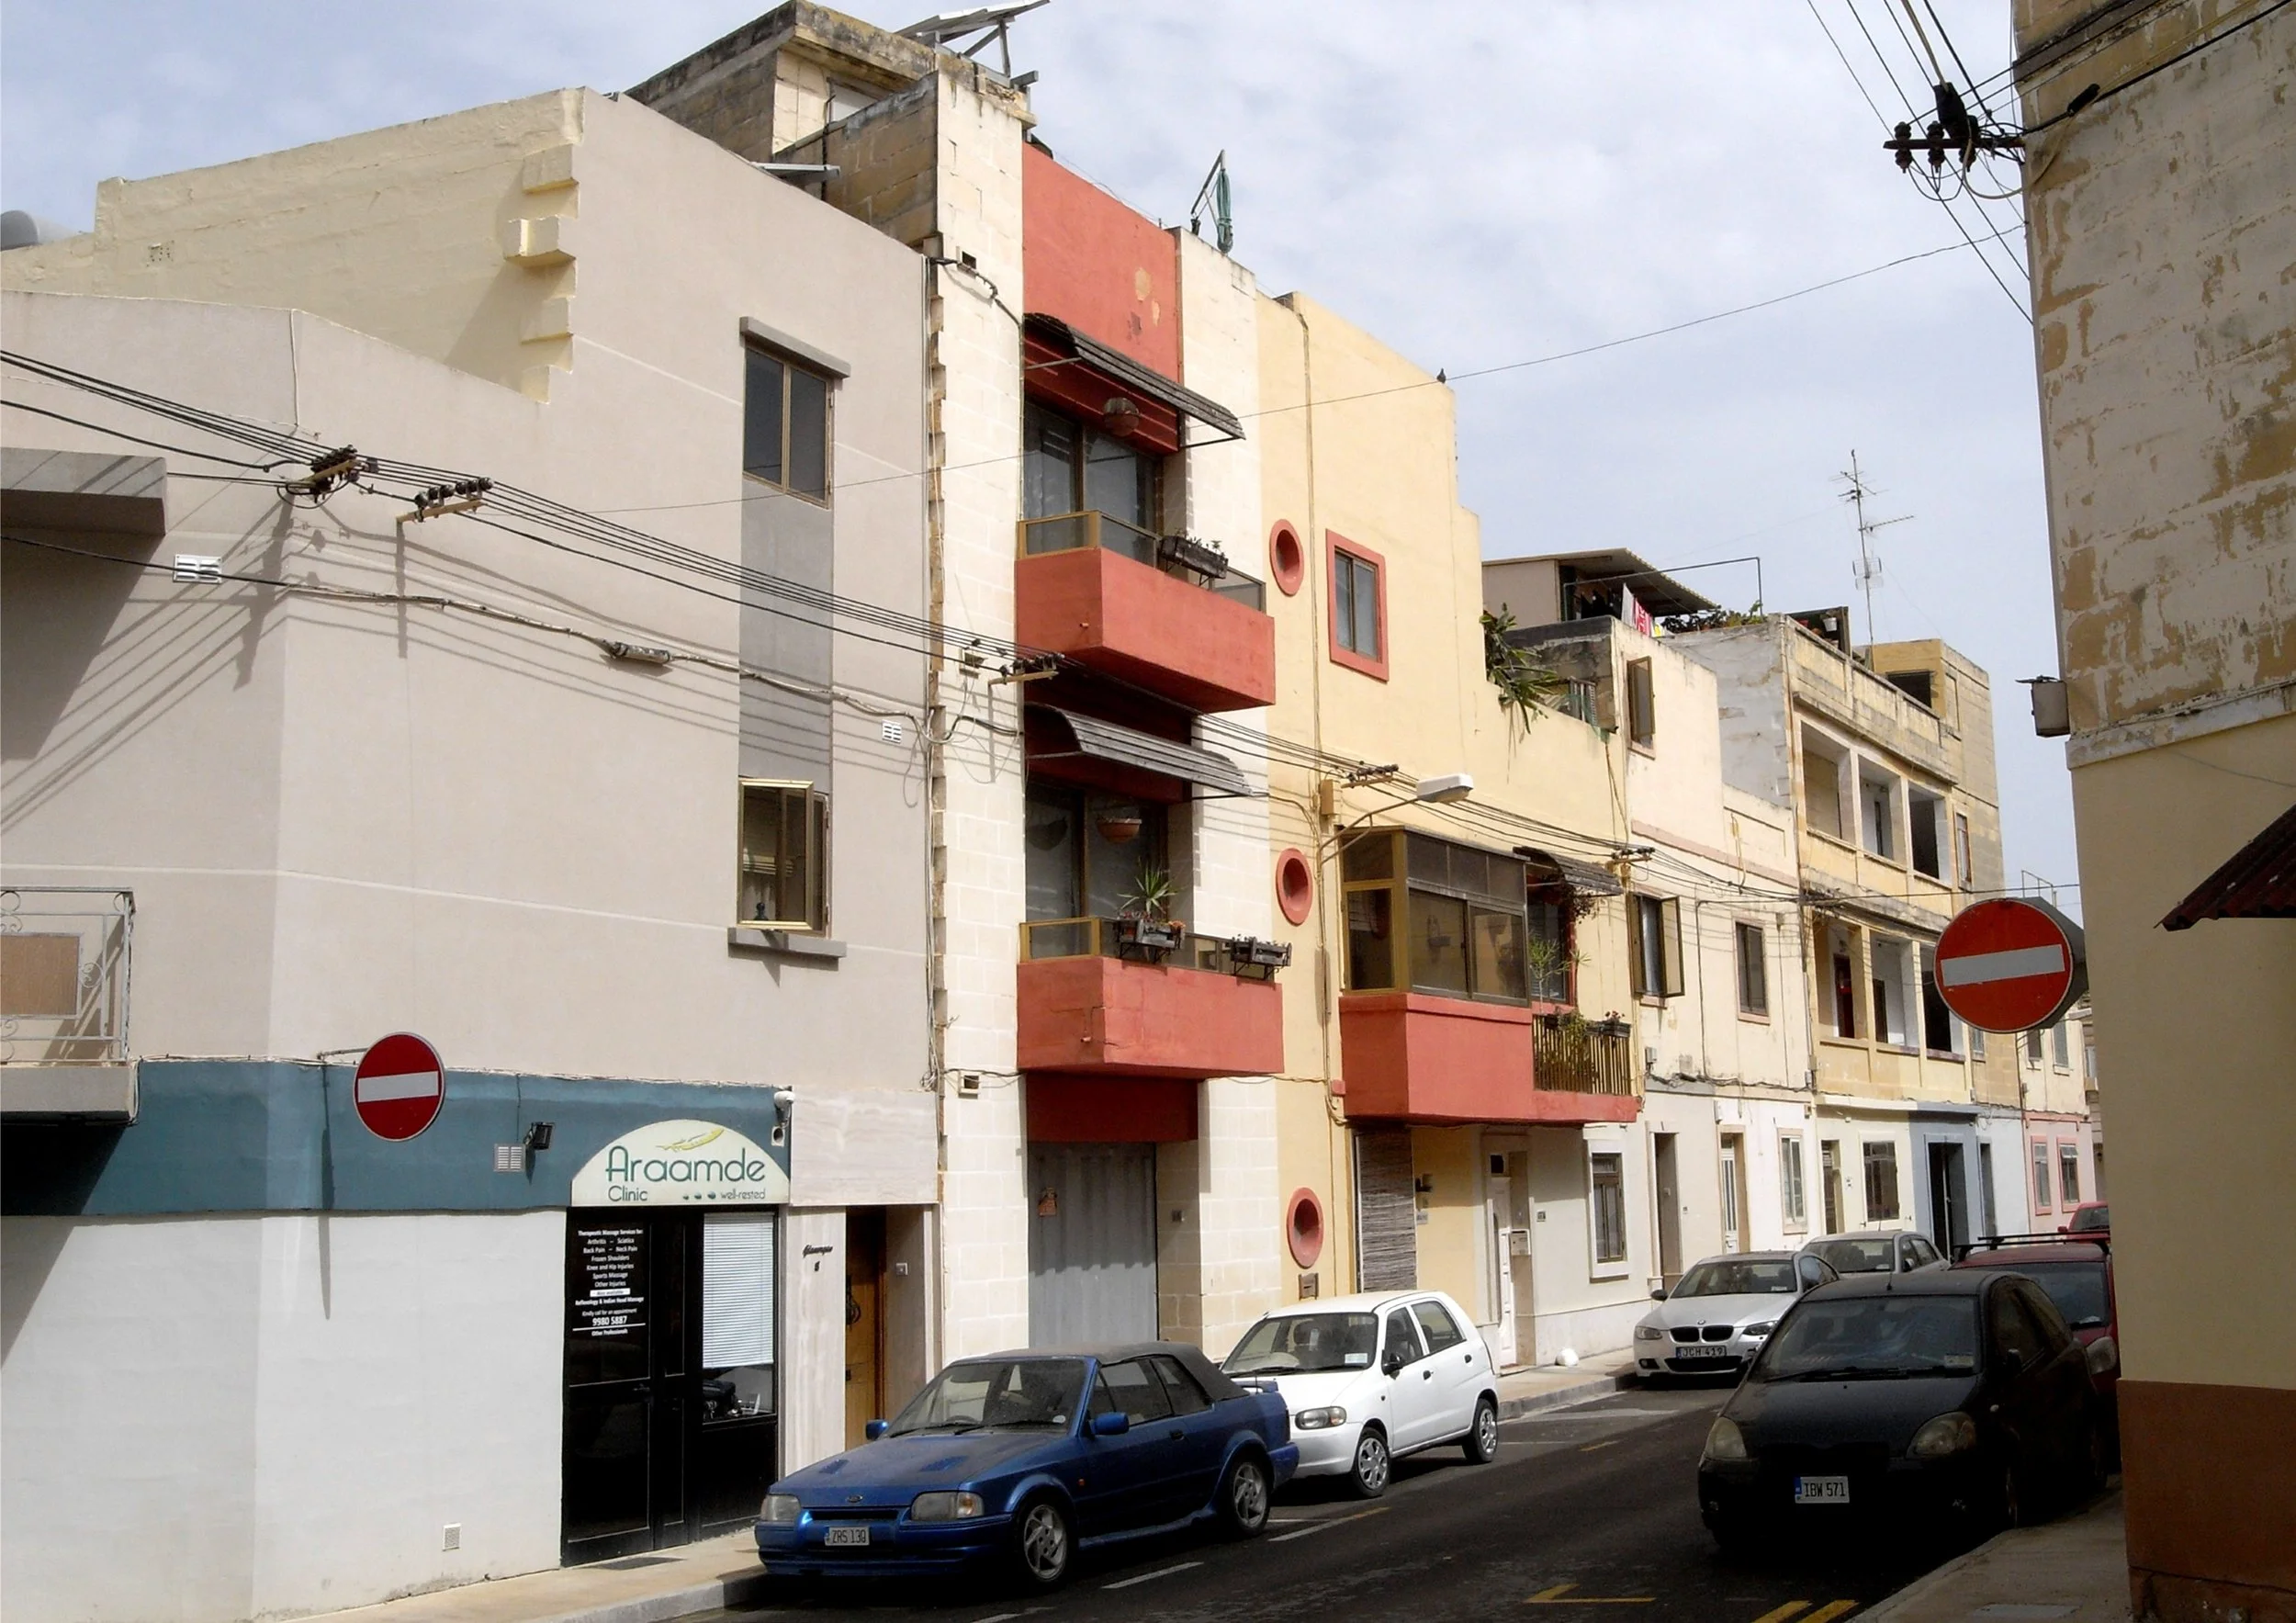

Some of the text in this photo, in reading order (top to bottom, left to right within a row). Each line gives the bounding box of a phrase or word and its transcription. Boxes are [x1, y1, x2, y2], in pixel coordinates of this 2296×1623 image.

[605, 1145, 766, 1182] Araamde
[608, 1185, 766, 1201] Clinic well-rested
[592, 1315, 627, 1326] 9980 5887
[1683, 1347, 1723, 1357] JCH 419
[1805, 1482, 1845, 1497] IBW 571
